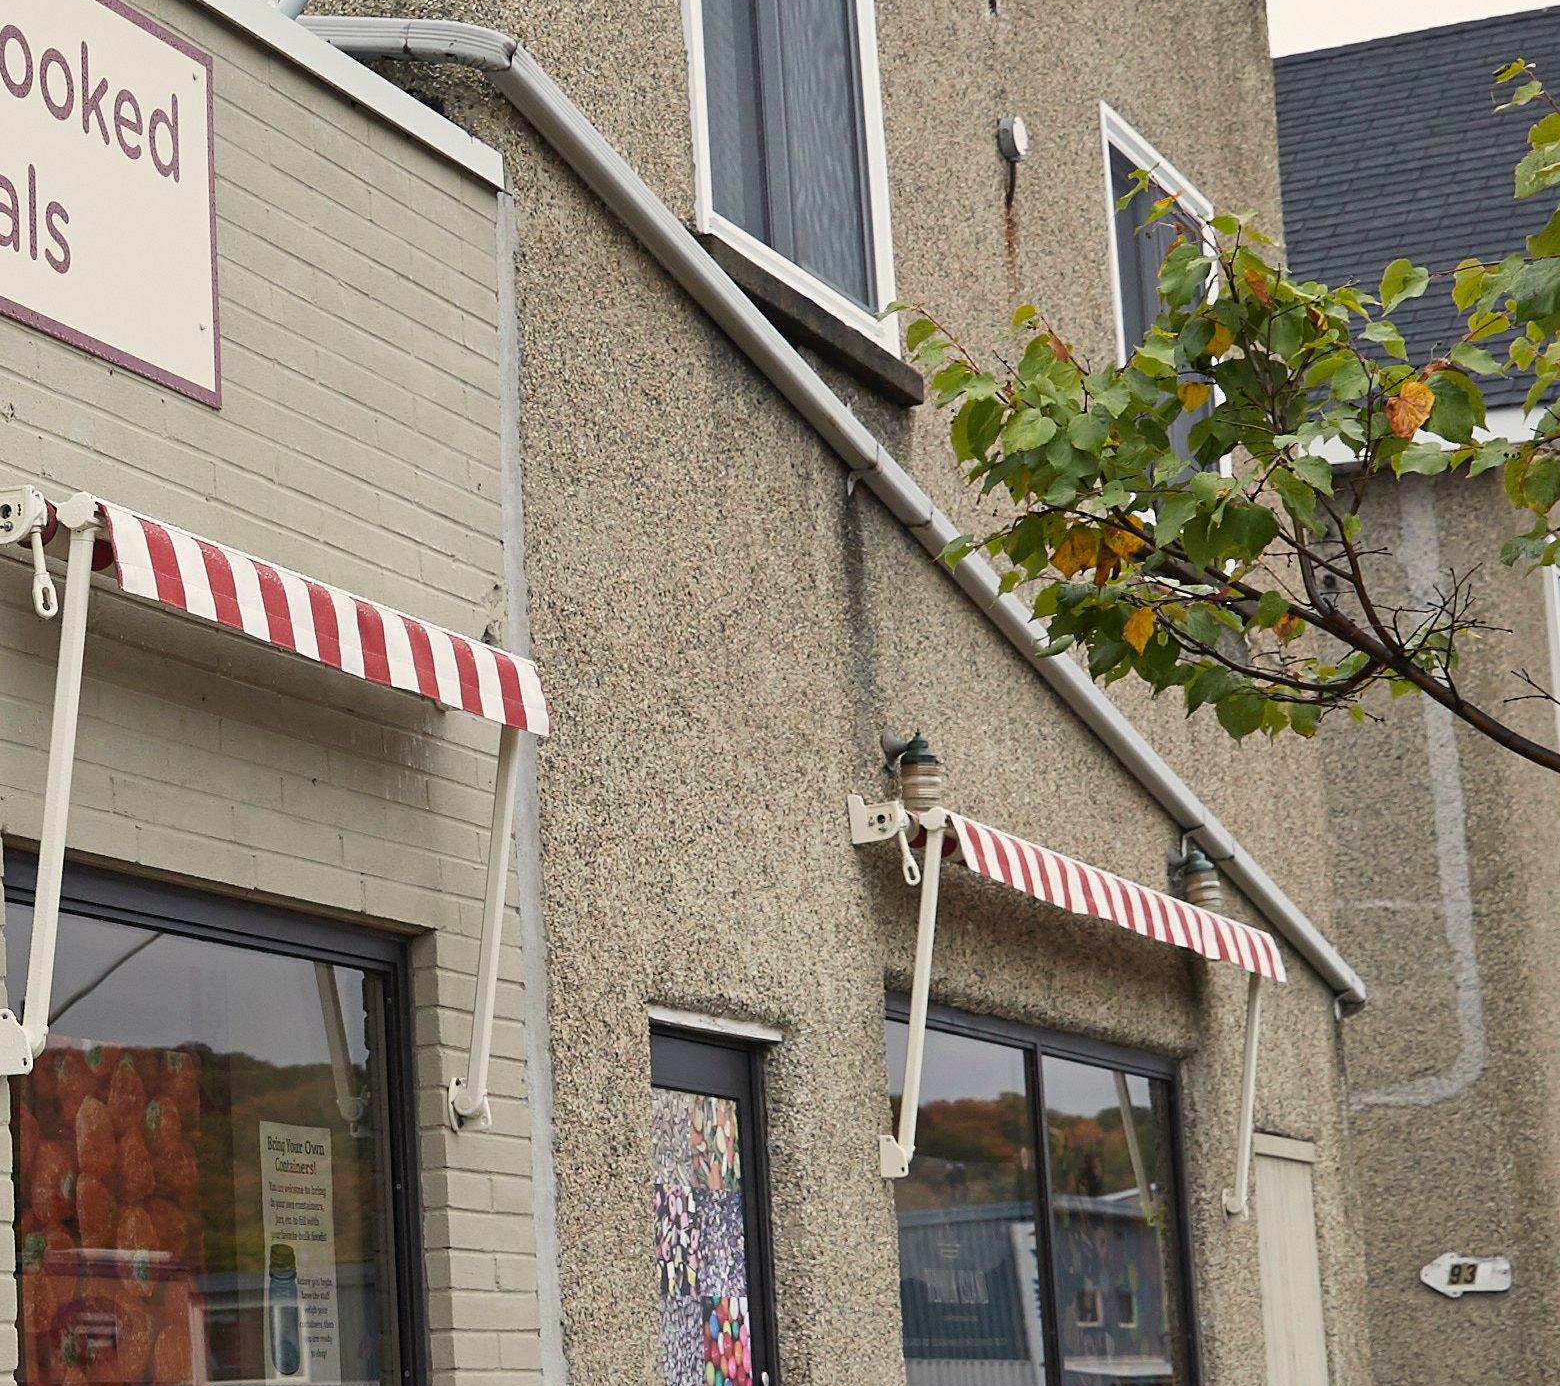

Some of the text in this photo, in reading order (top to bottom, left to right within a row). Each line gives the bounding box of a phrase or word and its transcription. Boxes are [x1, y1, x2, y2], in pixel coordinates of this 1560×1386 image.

[267, 1135, 326, 1156] Bring Your Own
[1449, 1263, 1478, 1285] 93
